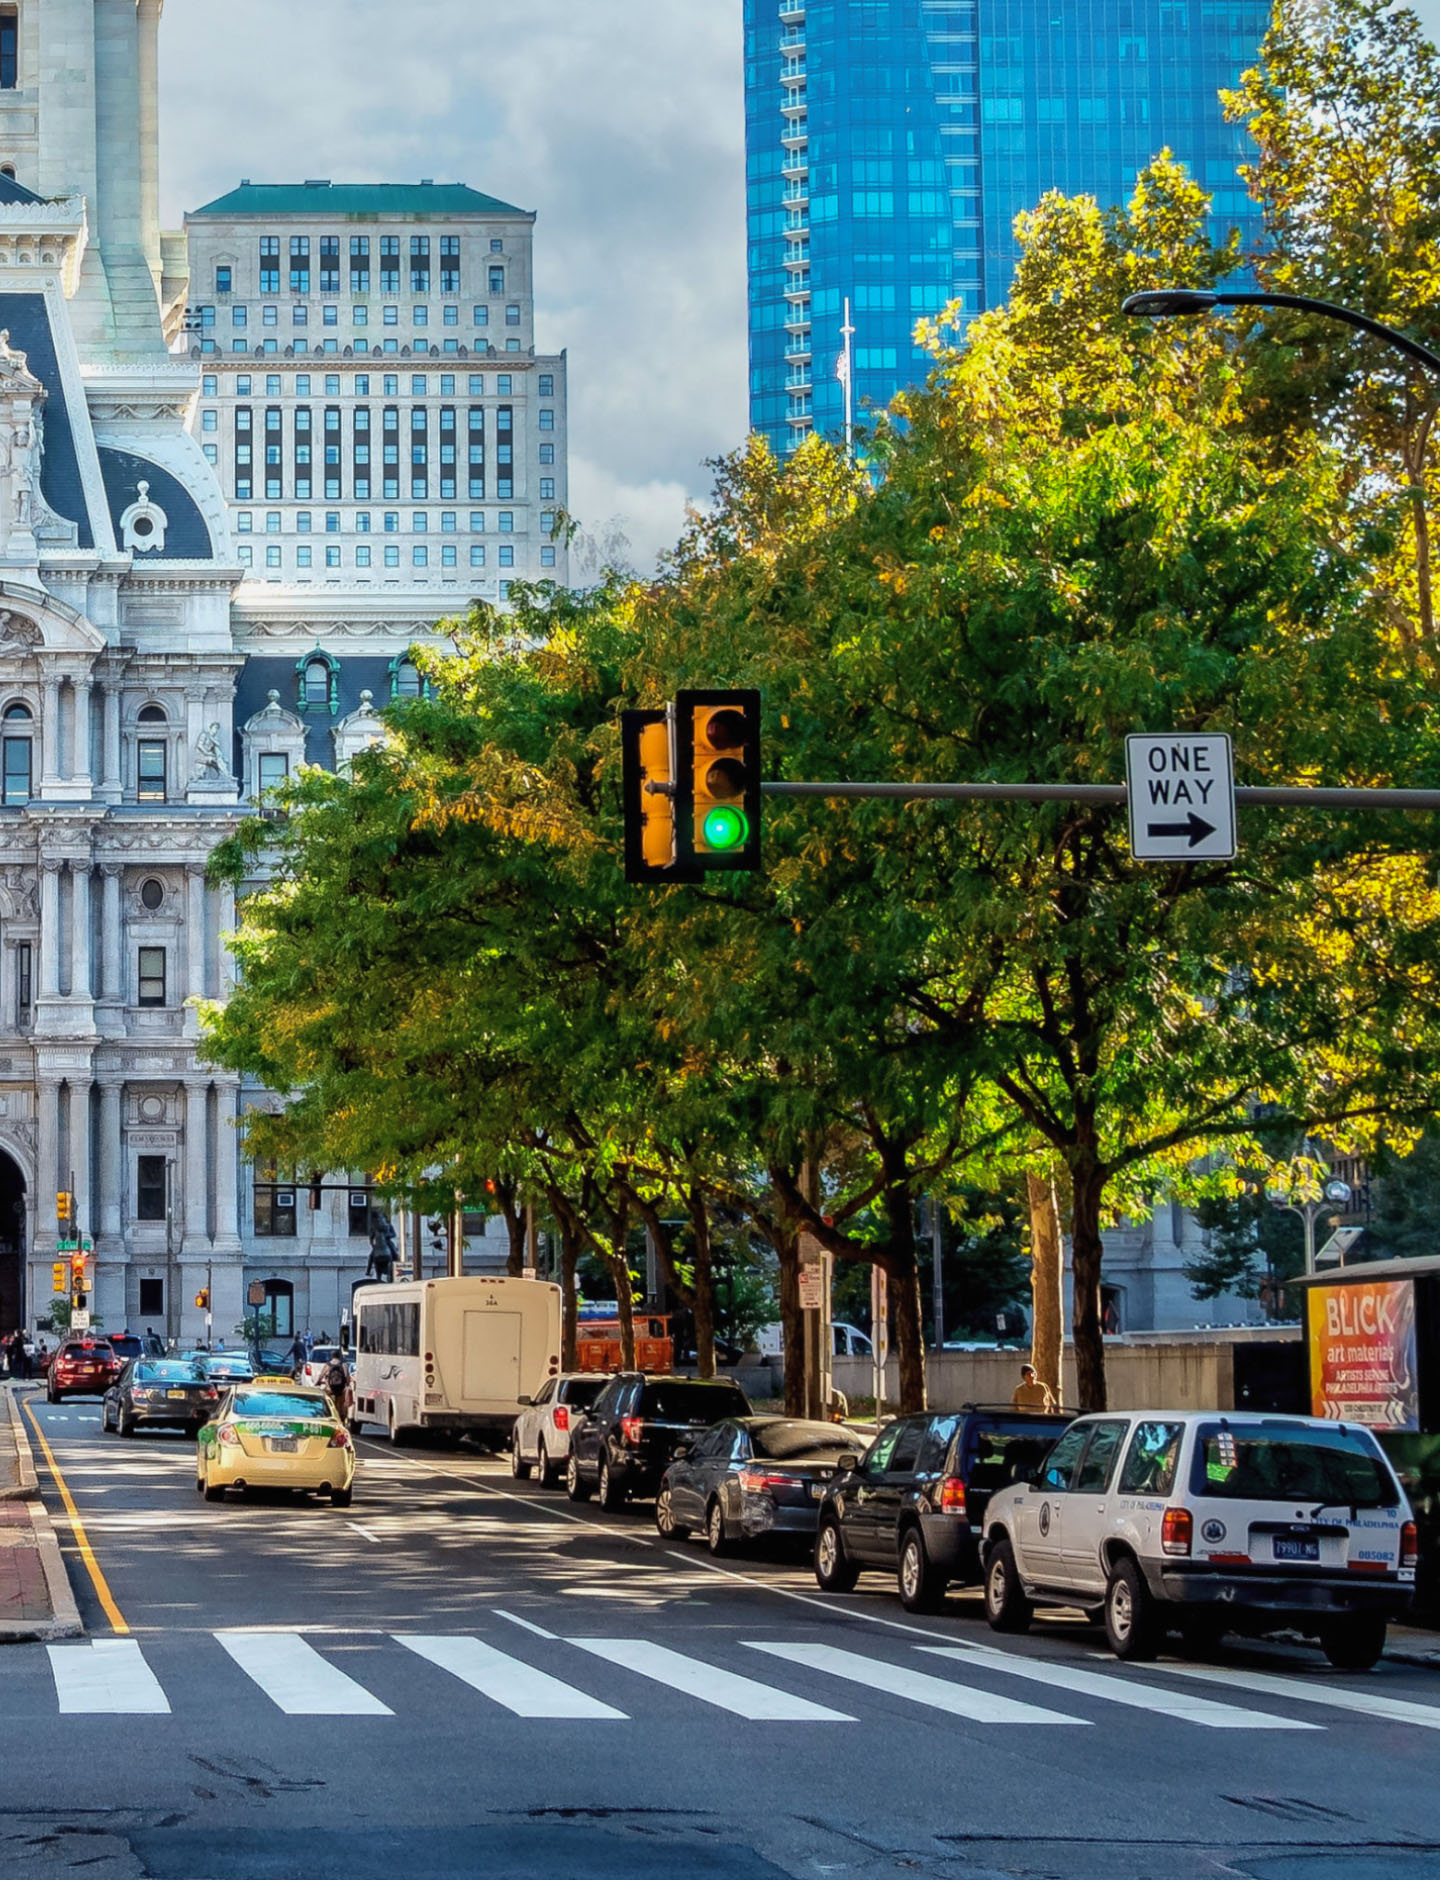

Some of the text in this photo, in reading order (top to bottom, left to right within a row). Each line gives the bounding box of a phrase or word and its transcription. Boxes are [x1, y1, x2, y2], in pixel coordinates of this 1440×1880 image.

[1148, 747, 1211, 773] ONE
[1148, 779, 1214, 805] WAY
[1326, 1294, 1395, 1337] BLICK
[1327, 1341, 1395, 1363] art materials
[1335, 1370, 1363, 1382] ARTISTS
[1325, 1381, 1398, 1394] PHILADELPHIA ARTISTS
[1332, 1518, 1343, 1527] OF
[1345, 1518, 1399, 1529] PHILADELPHIA
